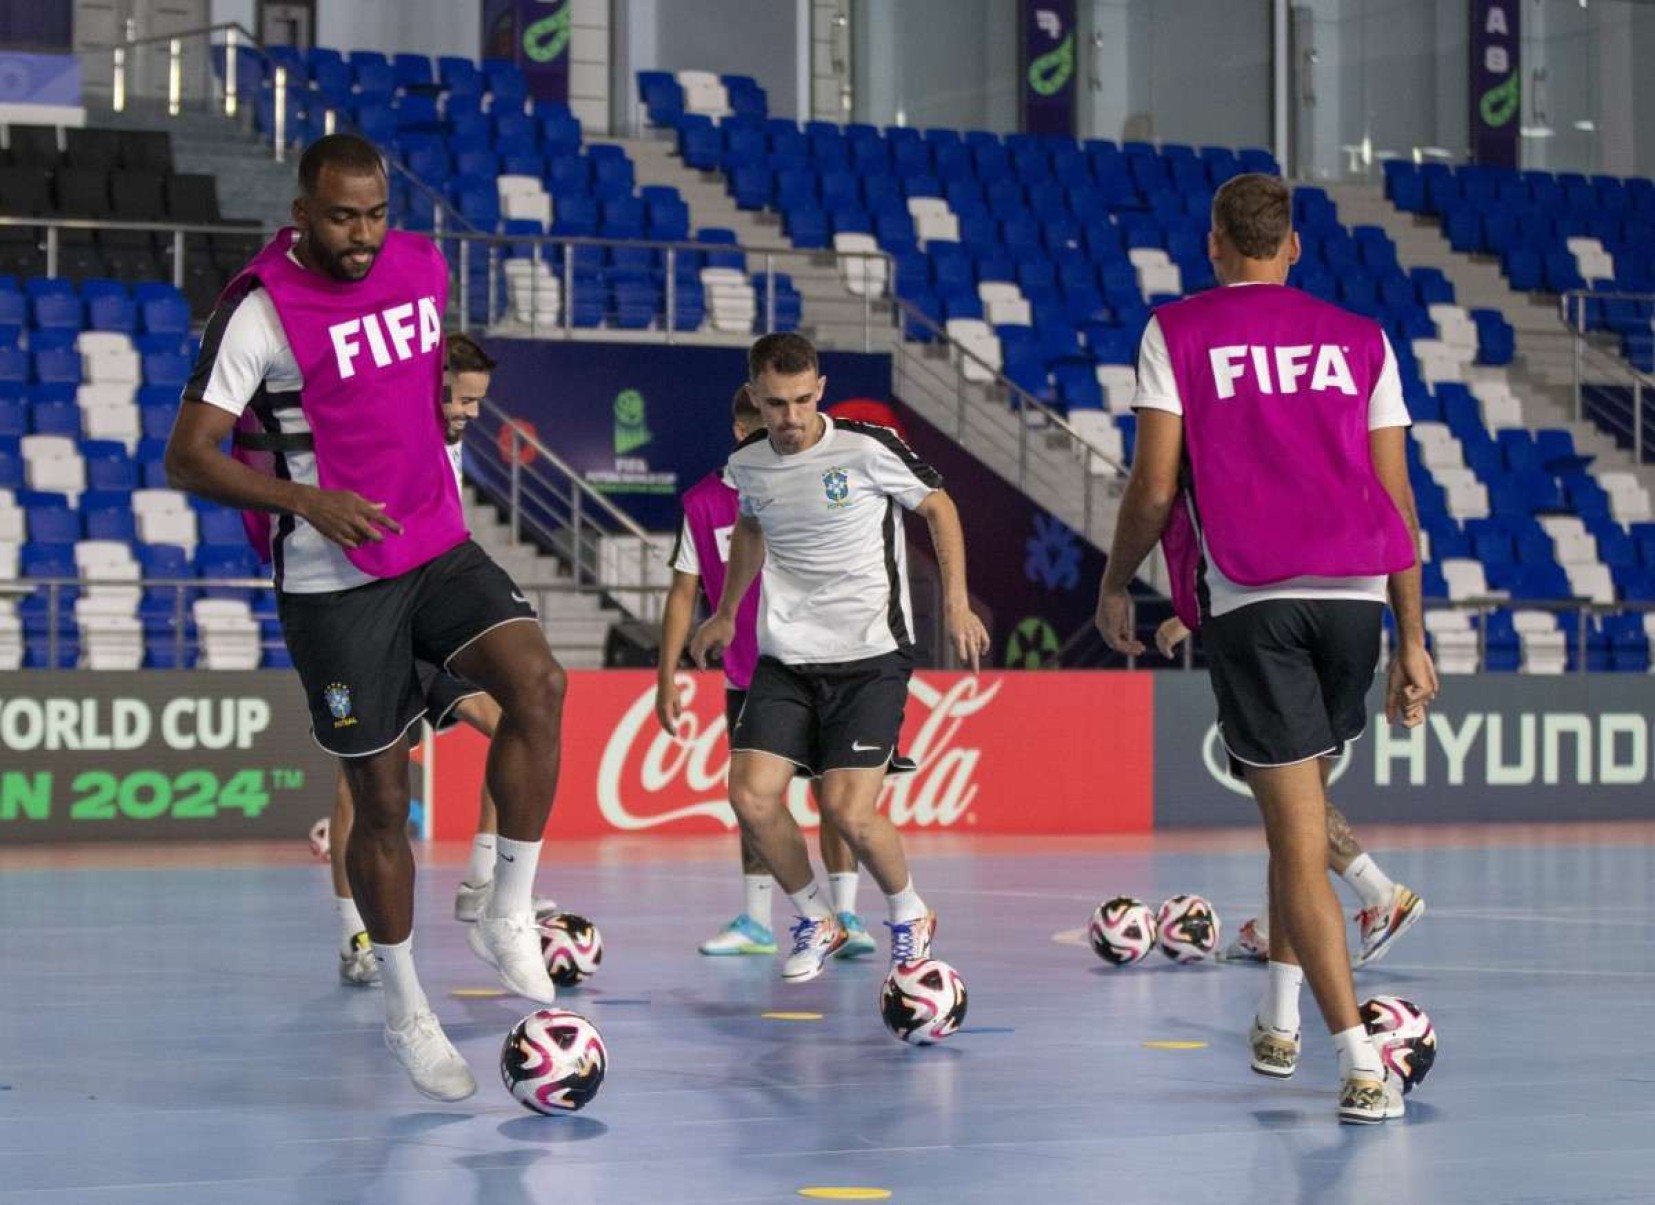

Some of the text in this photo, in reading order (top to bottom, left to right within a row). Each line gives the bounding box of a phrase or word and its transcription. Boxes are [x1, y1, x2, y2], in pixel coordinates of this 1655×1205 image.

[328, 297, 440, 379] FIFA
[1209, 344, 1358, 399] FIFA
[0, 698, 270, 750] ORLD CUP
[1374, 712, 1655, 786] HYUND
